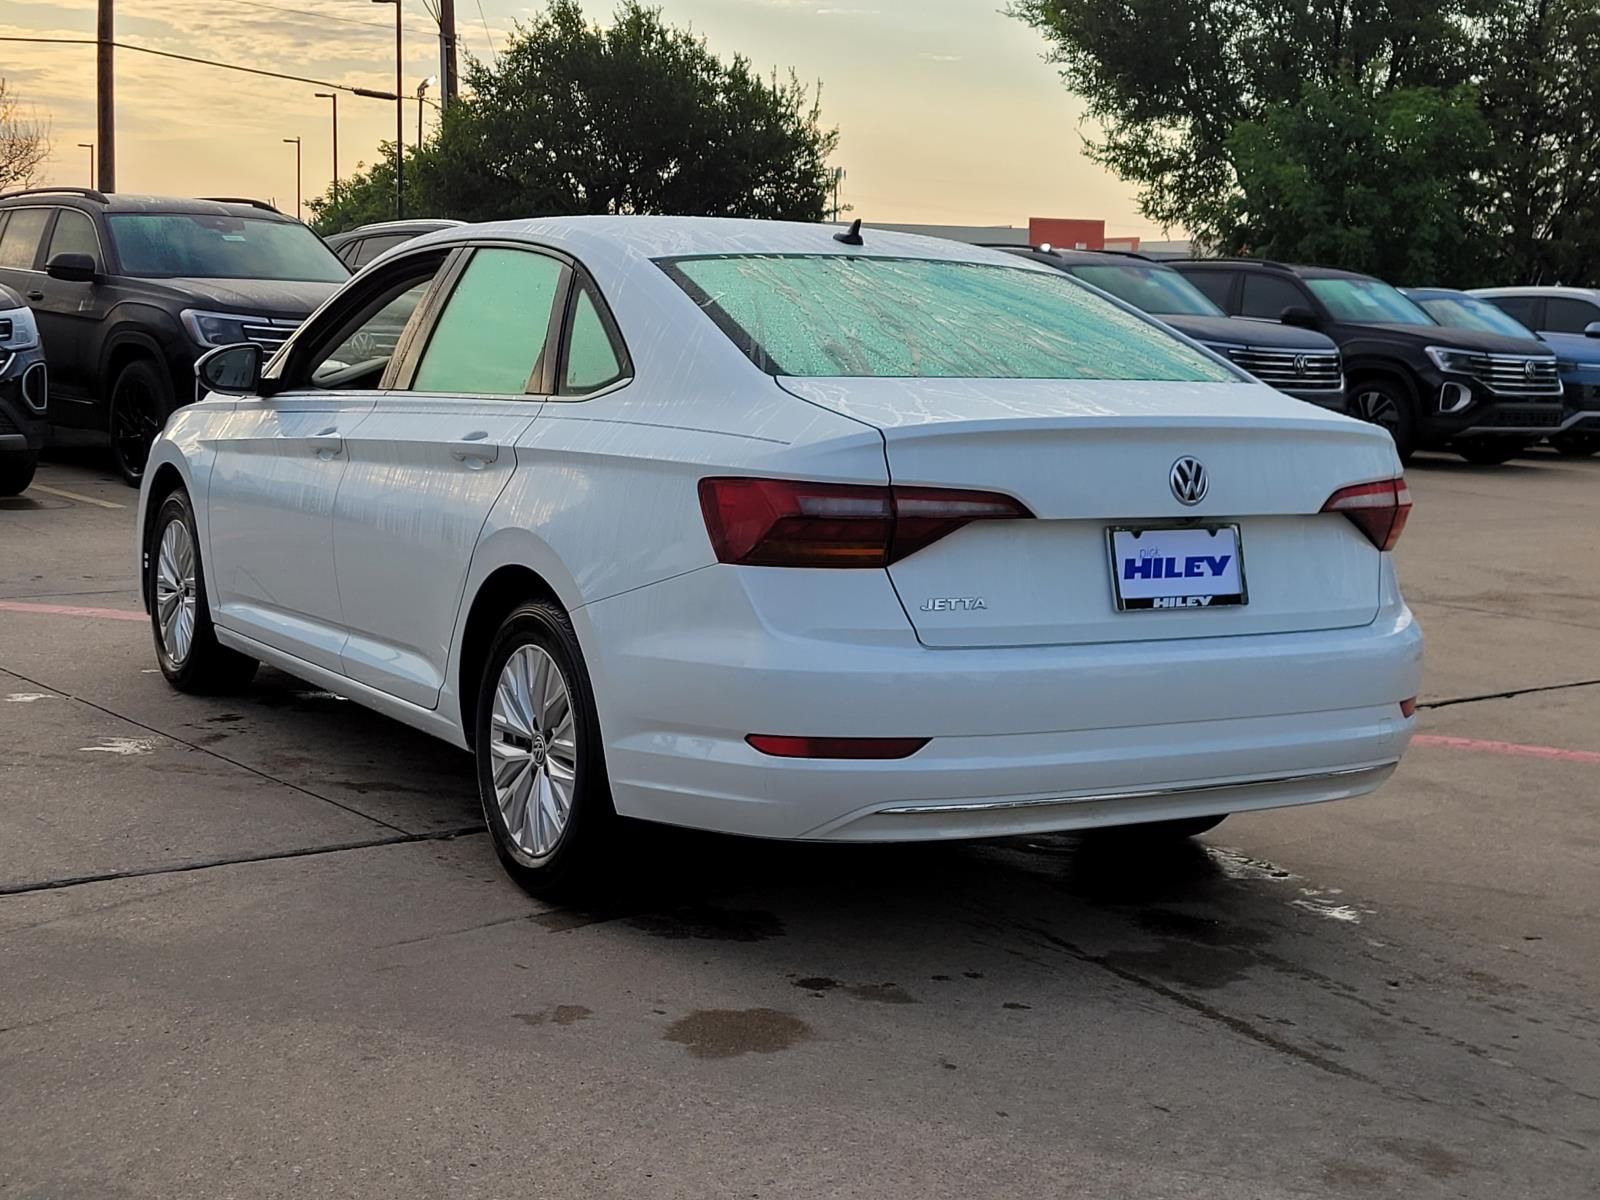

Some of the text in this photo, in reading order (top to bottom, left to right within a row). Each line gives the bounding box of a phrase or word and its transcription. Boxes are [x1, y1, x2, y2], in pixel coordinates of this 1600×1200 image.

[1170, 456, 1208, 505] VW
[1124, 555, 1231, 579] HILEY
[920, 597, 987, 611] JETTA
[1153, 595, 1213, 608] HILEY
